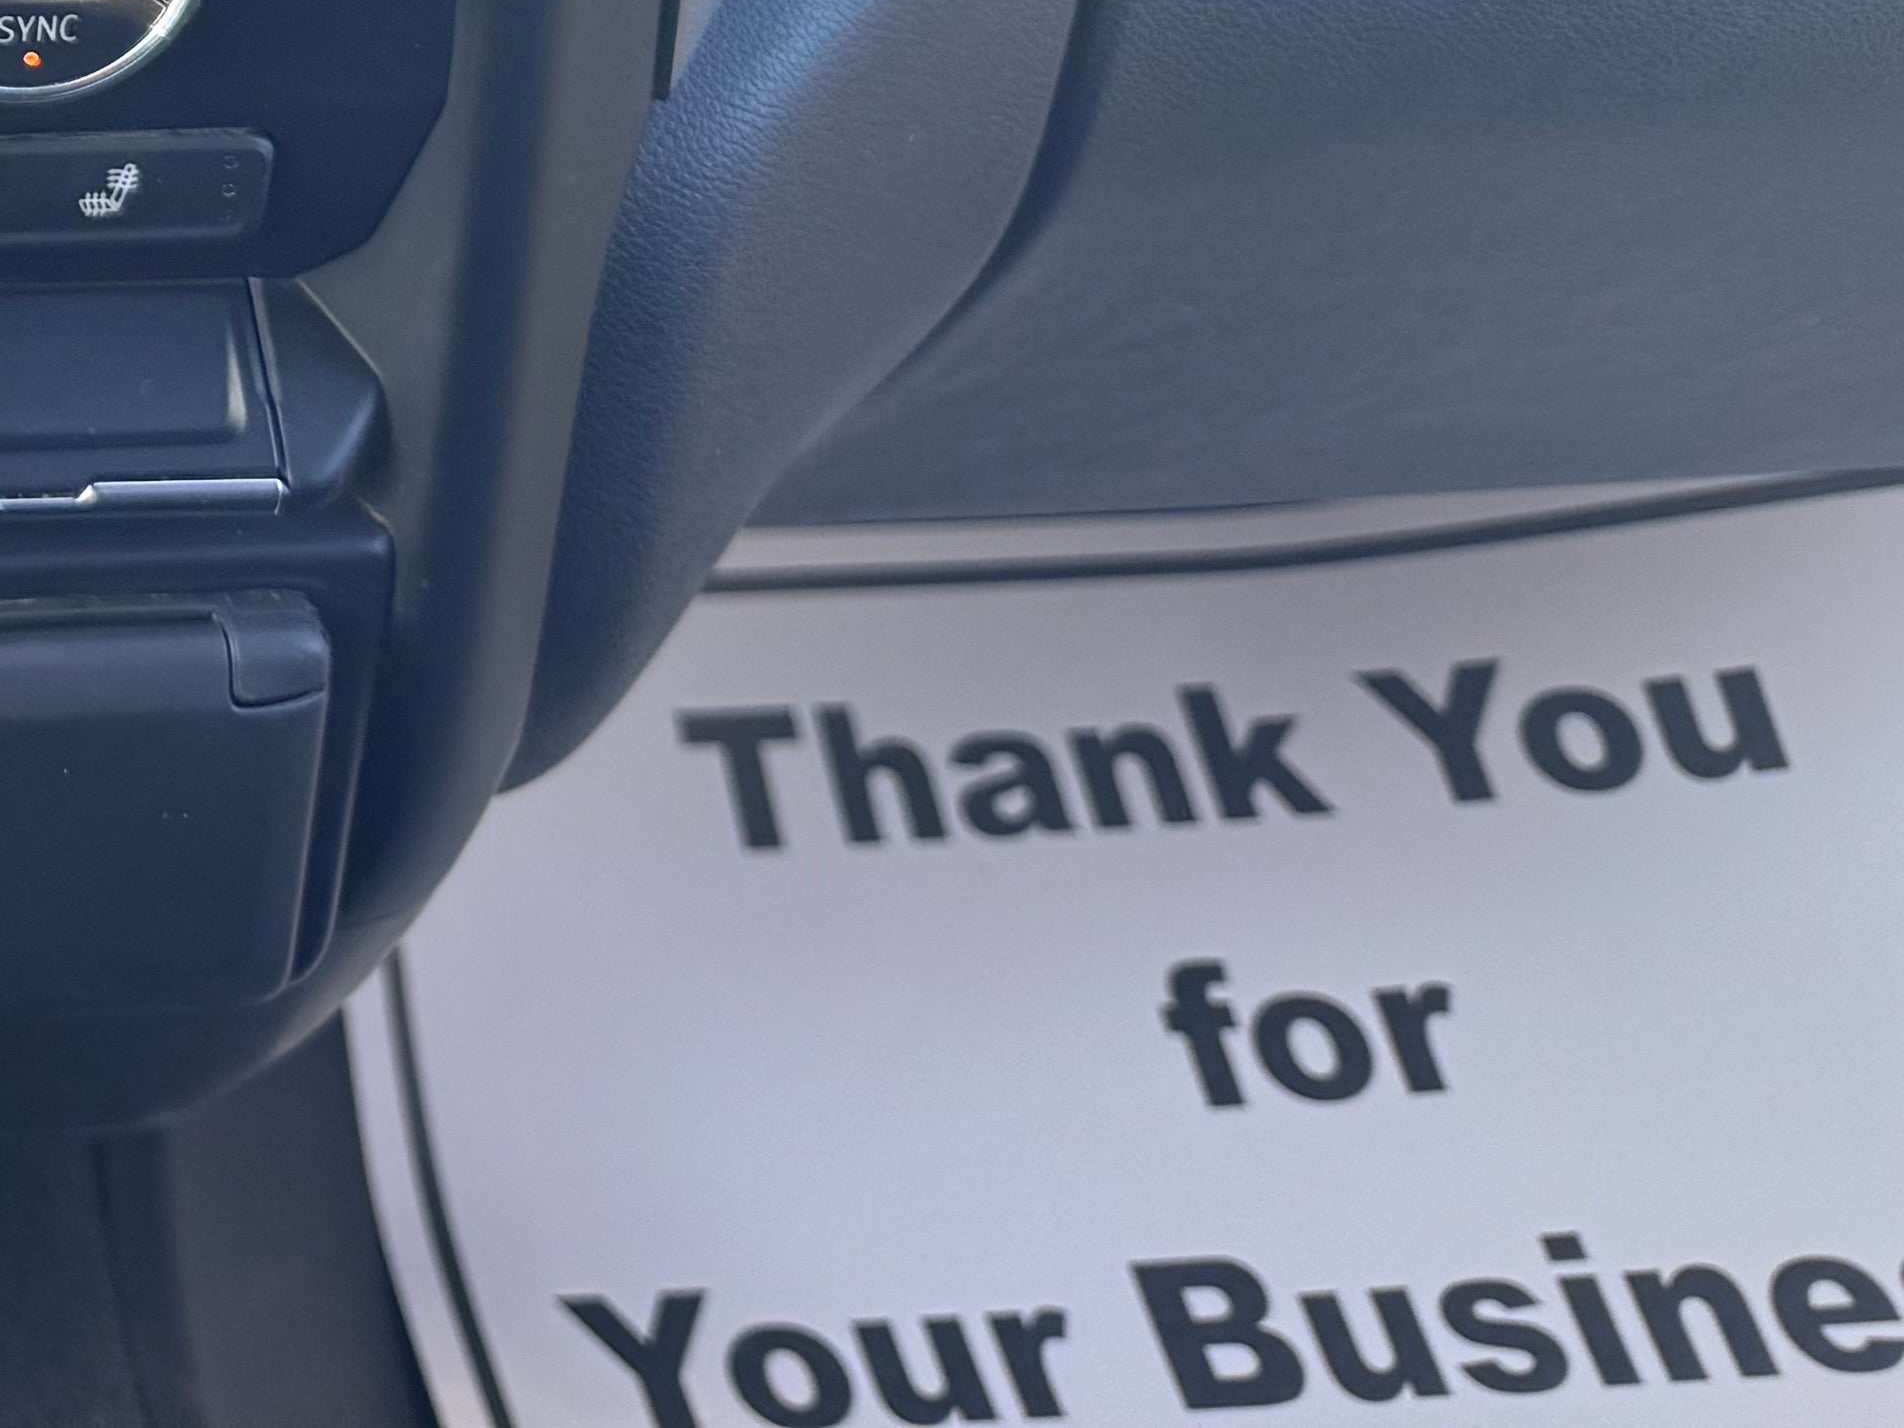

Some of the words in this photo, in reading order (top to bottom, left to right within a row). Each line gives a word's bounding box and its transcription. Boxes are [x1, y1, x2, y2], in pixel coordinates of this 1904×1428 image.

[676, 682, 1336, 852] Thank
[1353, 657, 1793, 805] You
[1157, 958, 1454, 1110] for
[558, 1286, 1069, 1428] Your
[1129, 1231, 1904, 1410] Busine
